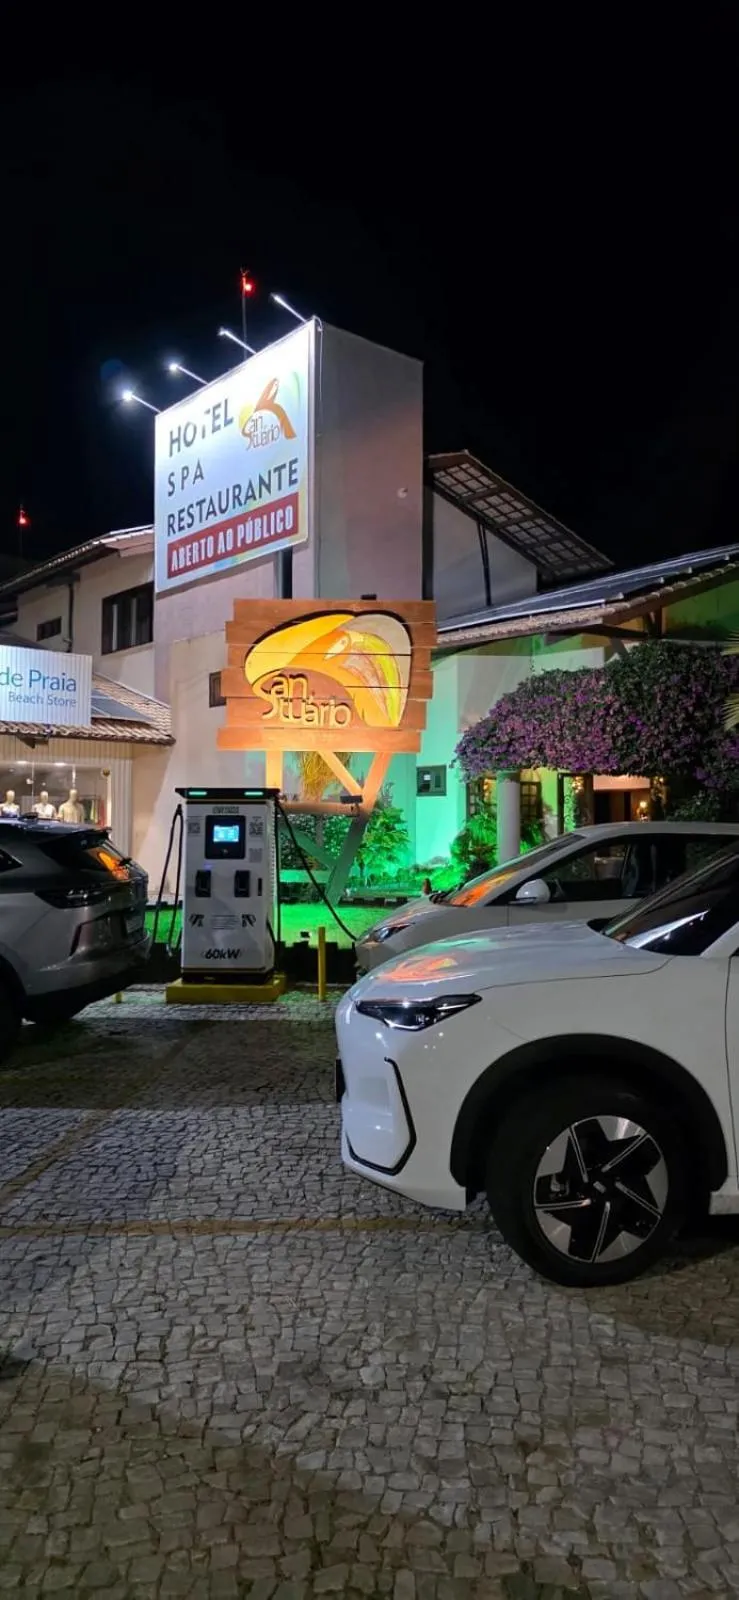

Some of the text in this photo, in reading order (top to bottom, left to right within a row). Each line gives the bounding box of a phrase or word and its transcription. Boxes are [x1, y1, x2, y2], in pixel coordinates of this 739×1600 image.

[167, 459, 204, 496] SPA
[167, 457, 299, 536] RESTAURANTE
[171, 505, 293, 571] ABERTO AO PÚBLICO
[0, 667, 77, 692] de Praia
[8, 691, 77, 707] Beach Store
[205, 948, 240, 960] 60kW
